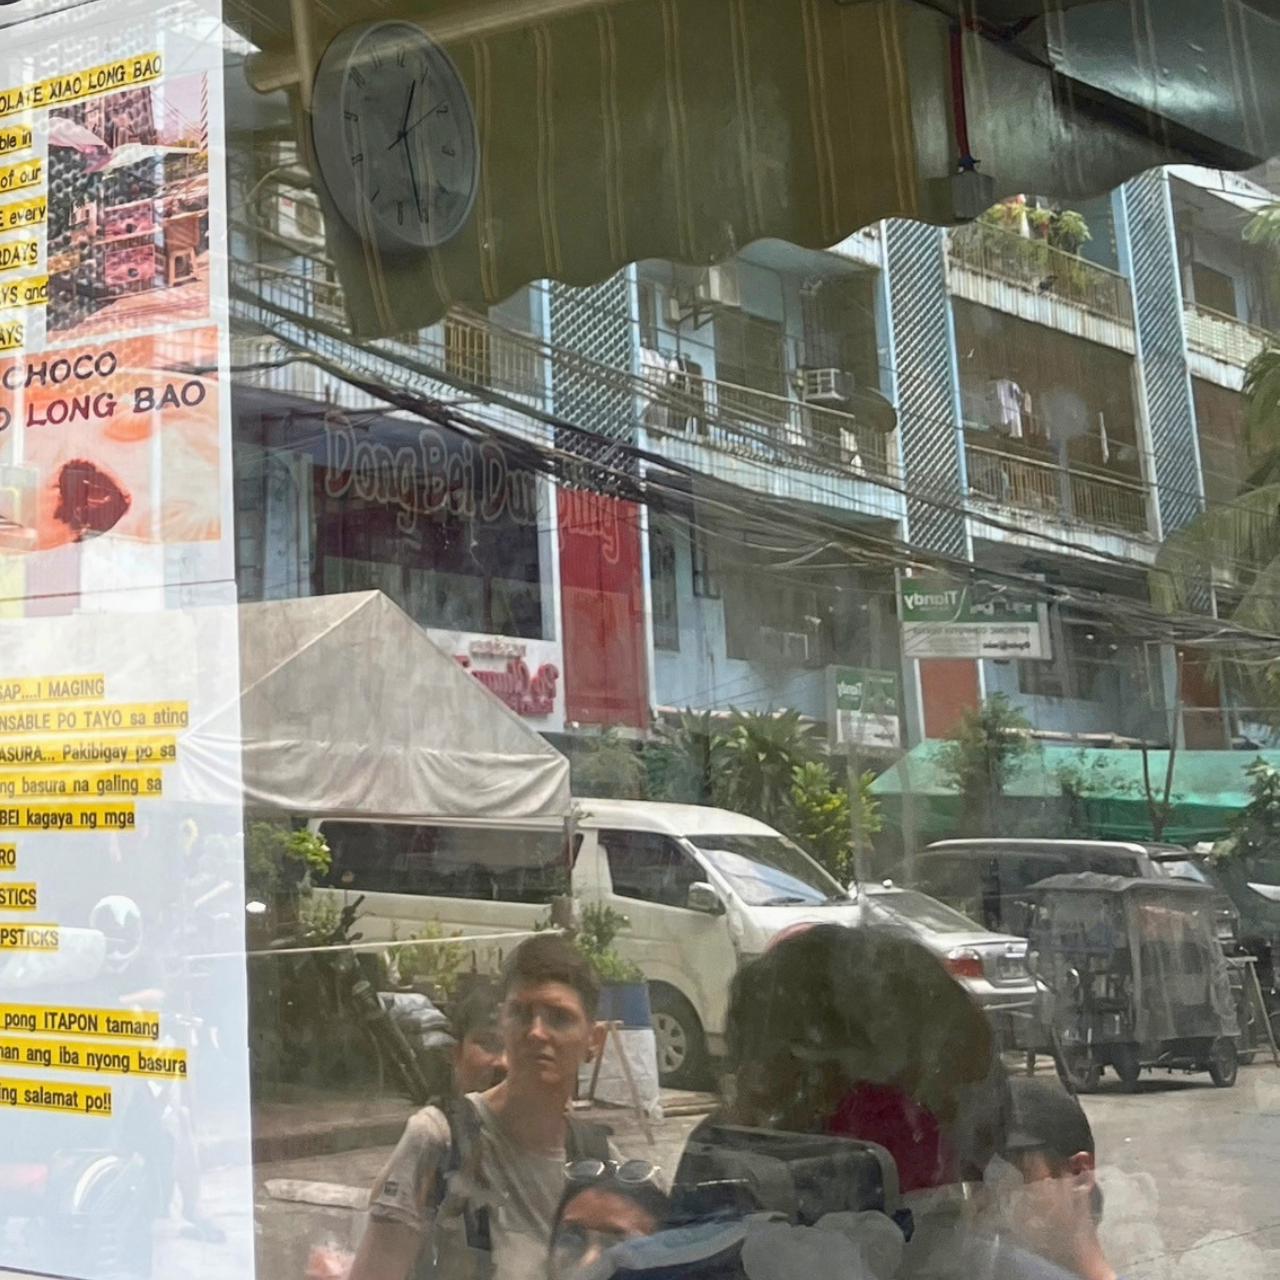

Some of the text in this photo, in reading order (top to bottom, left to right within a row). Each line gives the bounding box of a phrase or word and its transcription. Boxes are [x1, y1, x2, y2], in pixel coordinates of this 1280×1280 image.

[50, 76, 81, 99] XIAO
[88, 66, 125, 89] LONG
[133, 56, 161, 78] BAO
[22, 130, 32, 145] in
[1, 170, 14, 188] of
[20, 166, 41, 183] our
[10, 205, 46, 225] every
[24, 282, 48, 301] and
[2, 351, 117, 390] CHOCO
[27, 392, 116, 427] LONG
[133, 380, 205, 413] BAO
[5, 1013, 37, 1031] pong
[44, 1013, 98, 1032] ITAPON
[106, 1016, 159, 1040] tamang
[27, 1047, 51, 1066] ang
[59, 1046, 79, 1065] iba
[87, 1053, 130, 1073] nyong
[138, 1052, 186, 1073] basura
[24, 1086, 78, 1107] salamat
[85, 1093, 112, 1113] po!!
